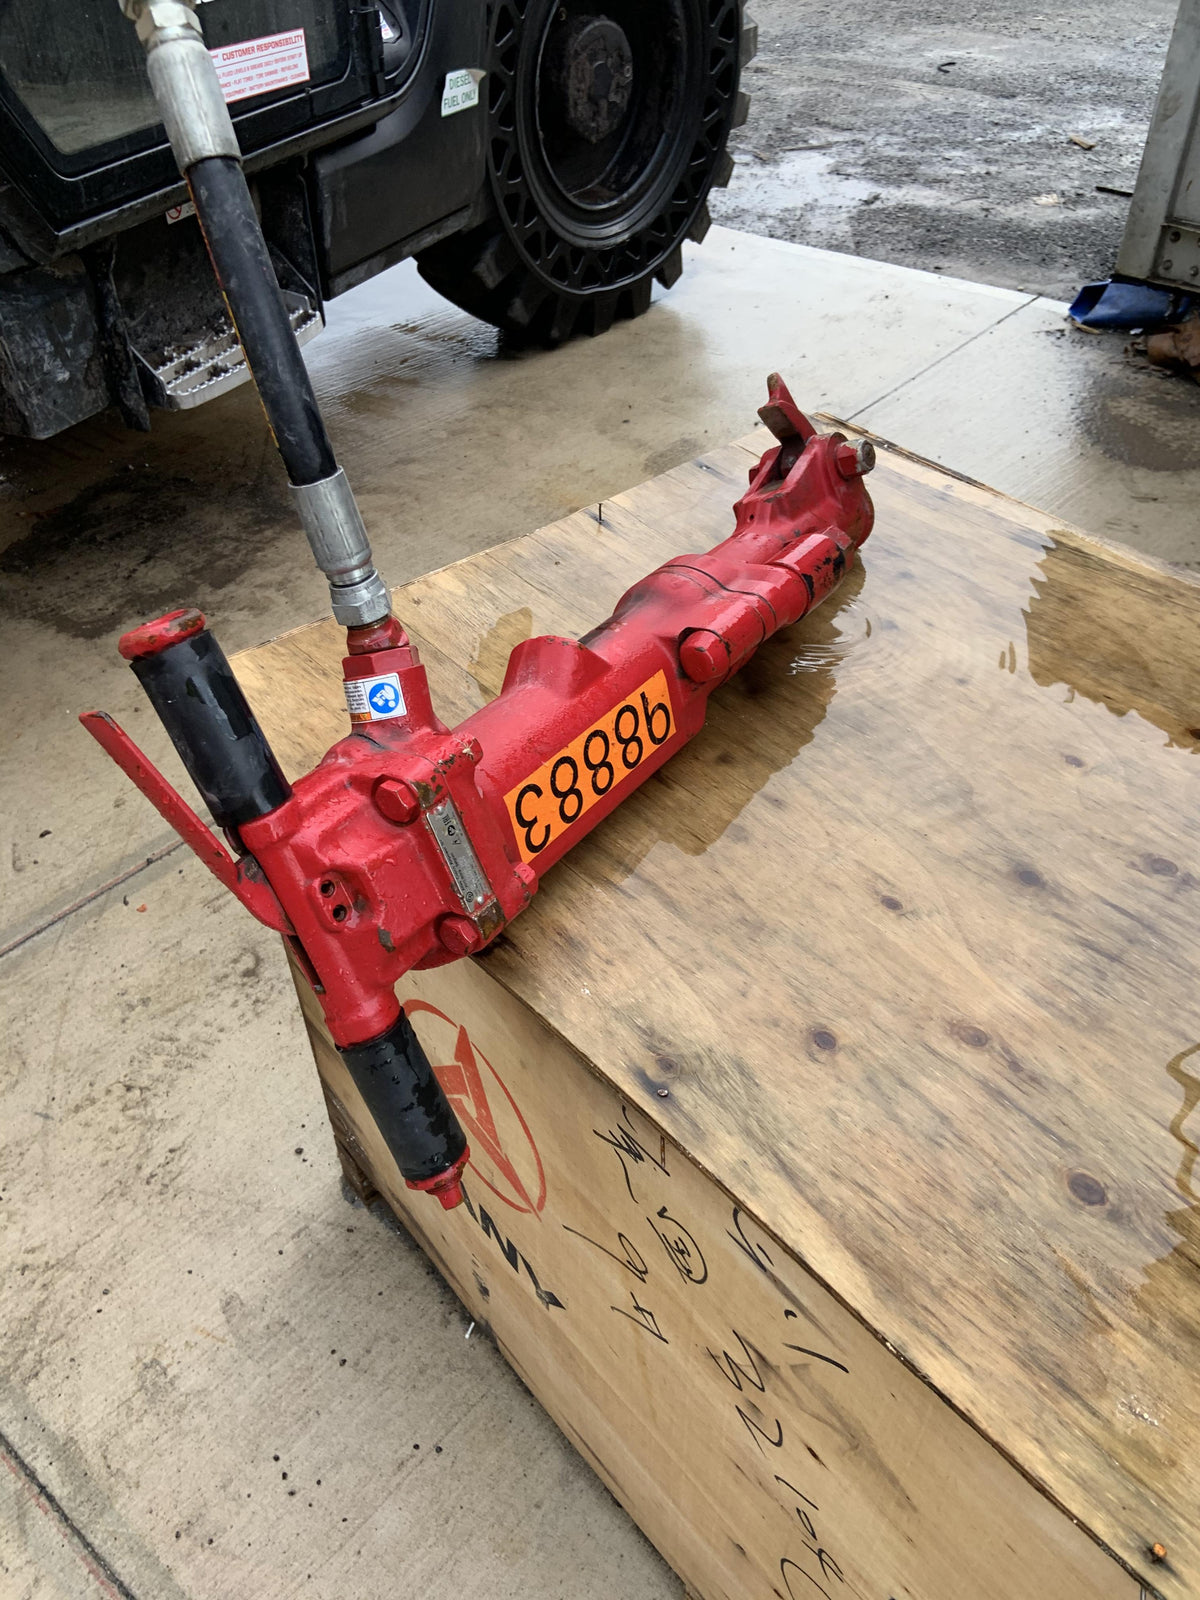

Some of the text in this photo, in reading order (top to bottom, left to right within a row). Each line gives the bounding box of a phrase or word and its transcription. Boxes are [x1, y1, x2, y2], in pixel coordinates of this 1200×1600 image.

[222, 34, 303, 61] CUSTOMER RESPONSIBILITY
[449, 74, 471, 89] DIESEL
[443, 89, 477, 109] FUEL ONLY
[515, 691, 671, 854] 98883
